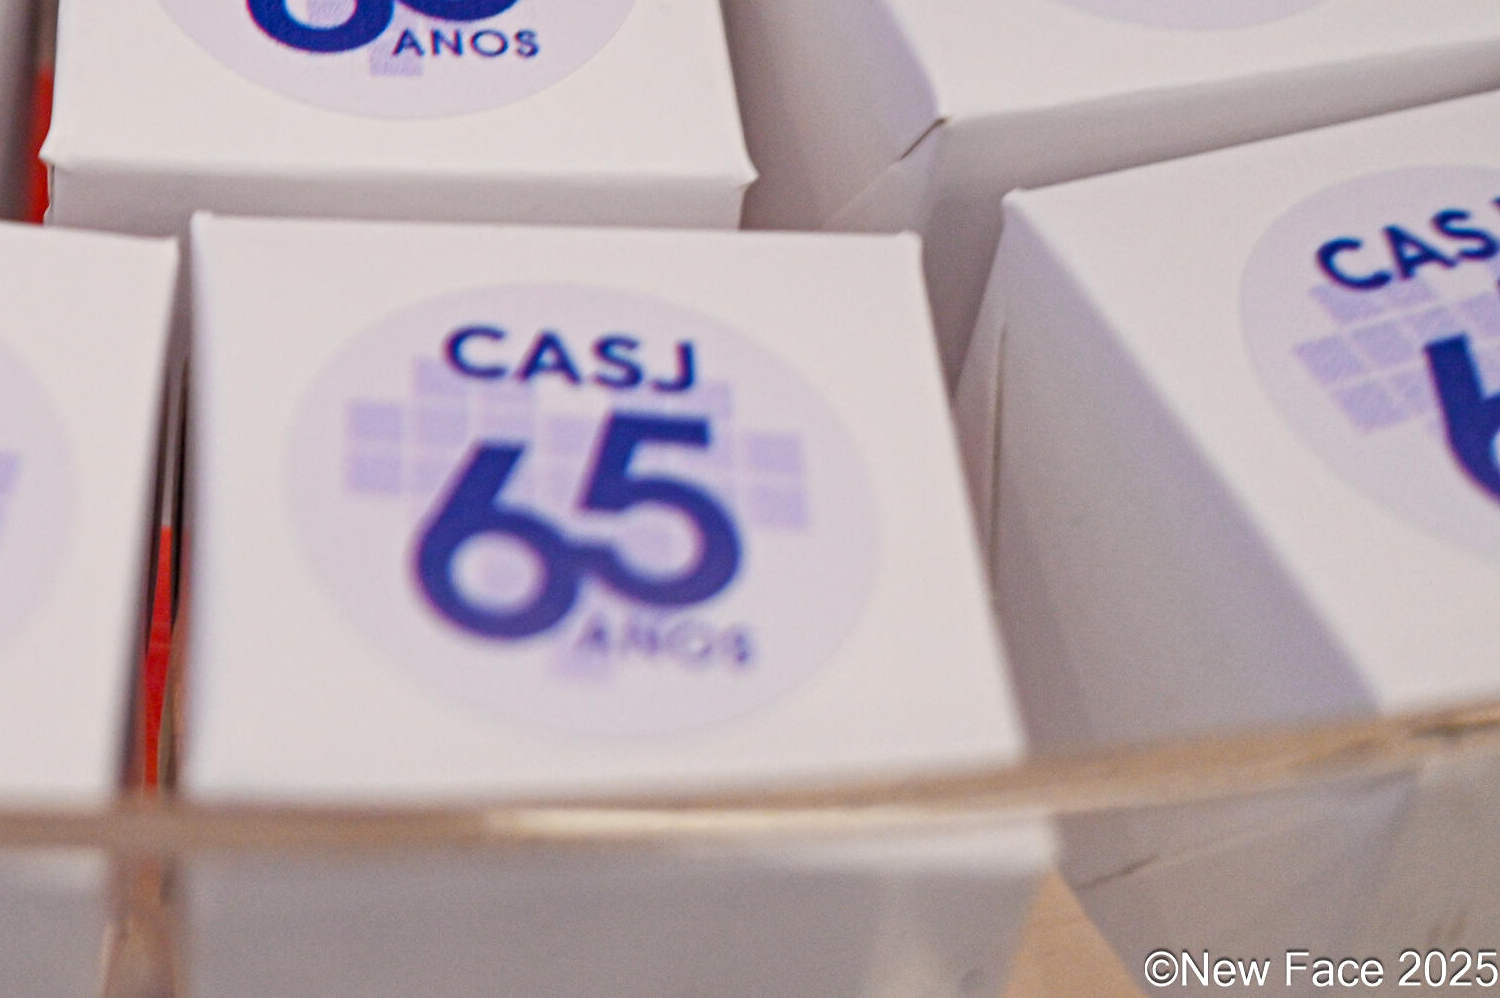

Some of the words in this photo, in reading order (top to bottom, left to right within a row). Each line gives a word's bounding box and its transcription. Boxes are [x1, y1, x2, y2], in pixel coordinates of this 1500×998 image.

[392, 28, 540, 58] ANOS
[1315, 197, 1500, 291] CAS
[445, 324, 699, 394] CASJ
[412, 409, 745, 642] 65
